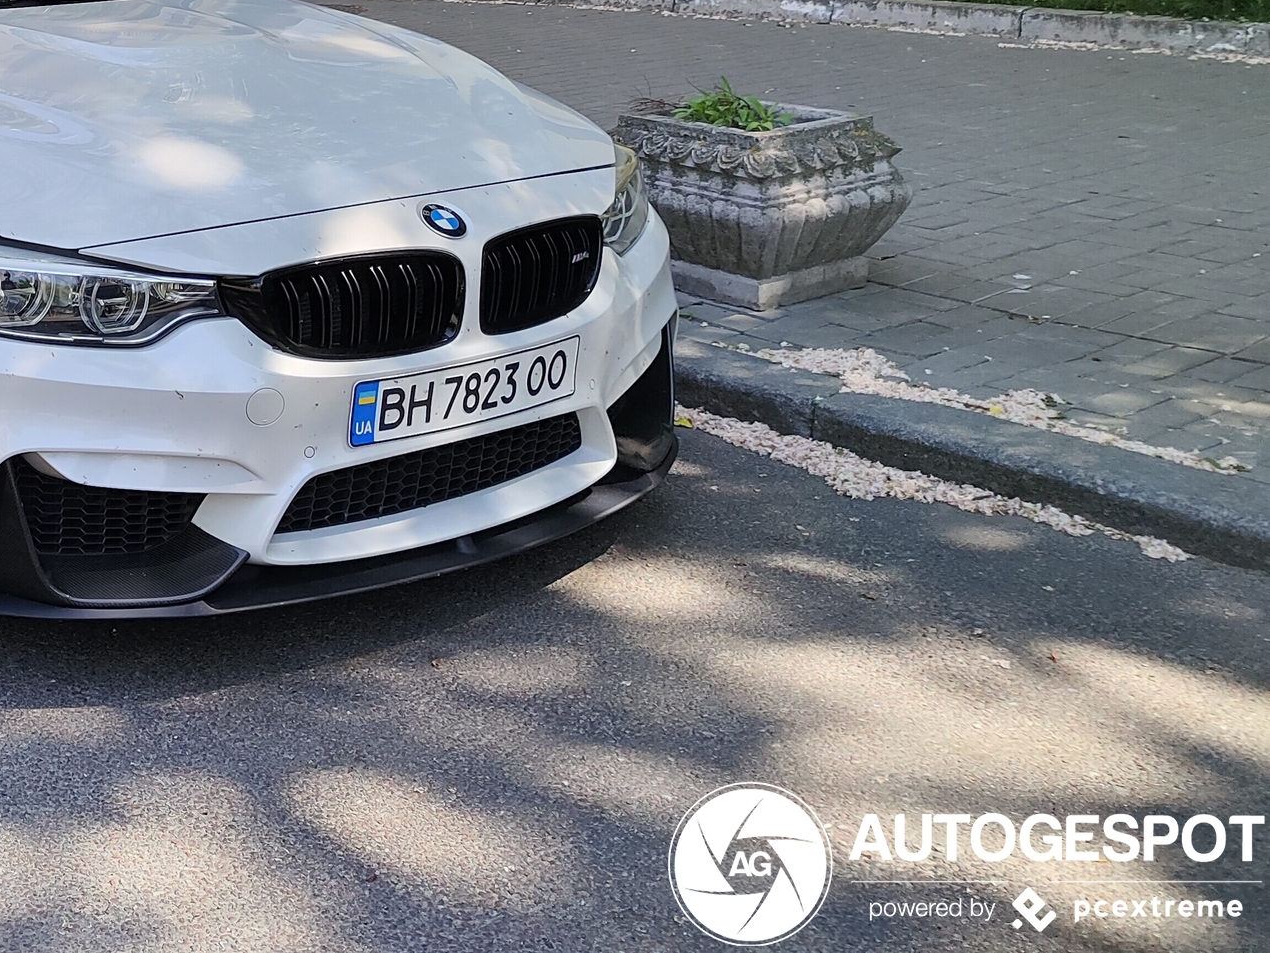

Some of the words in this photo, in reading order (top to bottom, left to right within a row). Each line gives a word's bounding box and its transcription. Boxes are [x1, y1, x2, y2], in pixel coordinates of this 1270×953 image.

[378, 381, 434, 432] BH
[442, 362, 520, 421] 7823
[355, 421, 373, 436] UA
